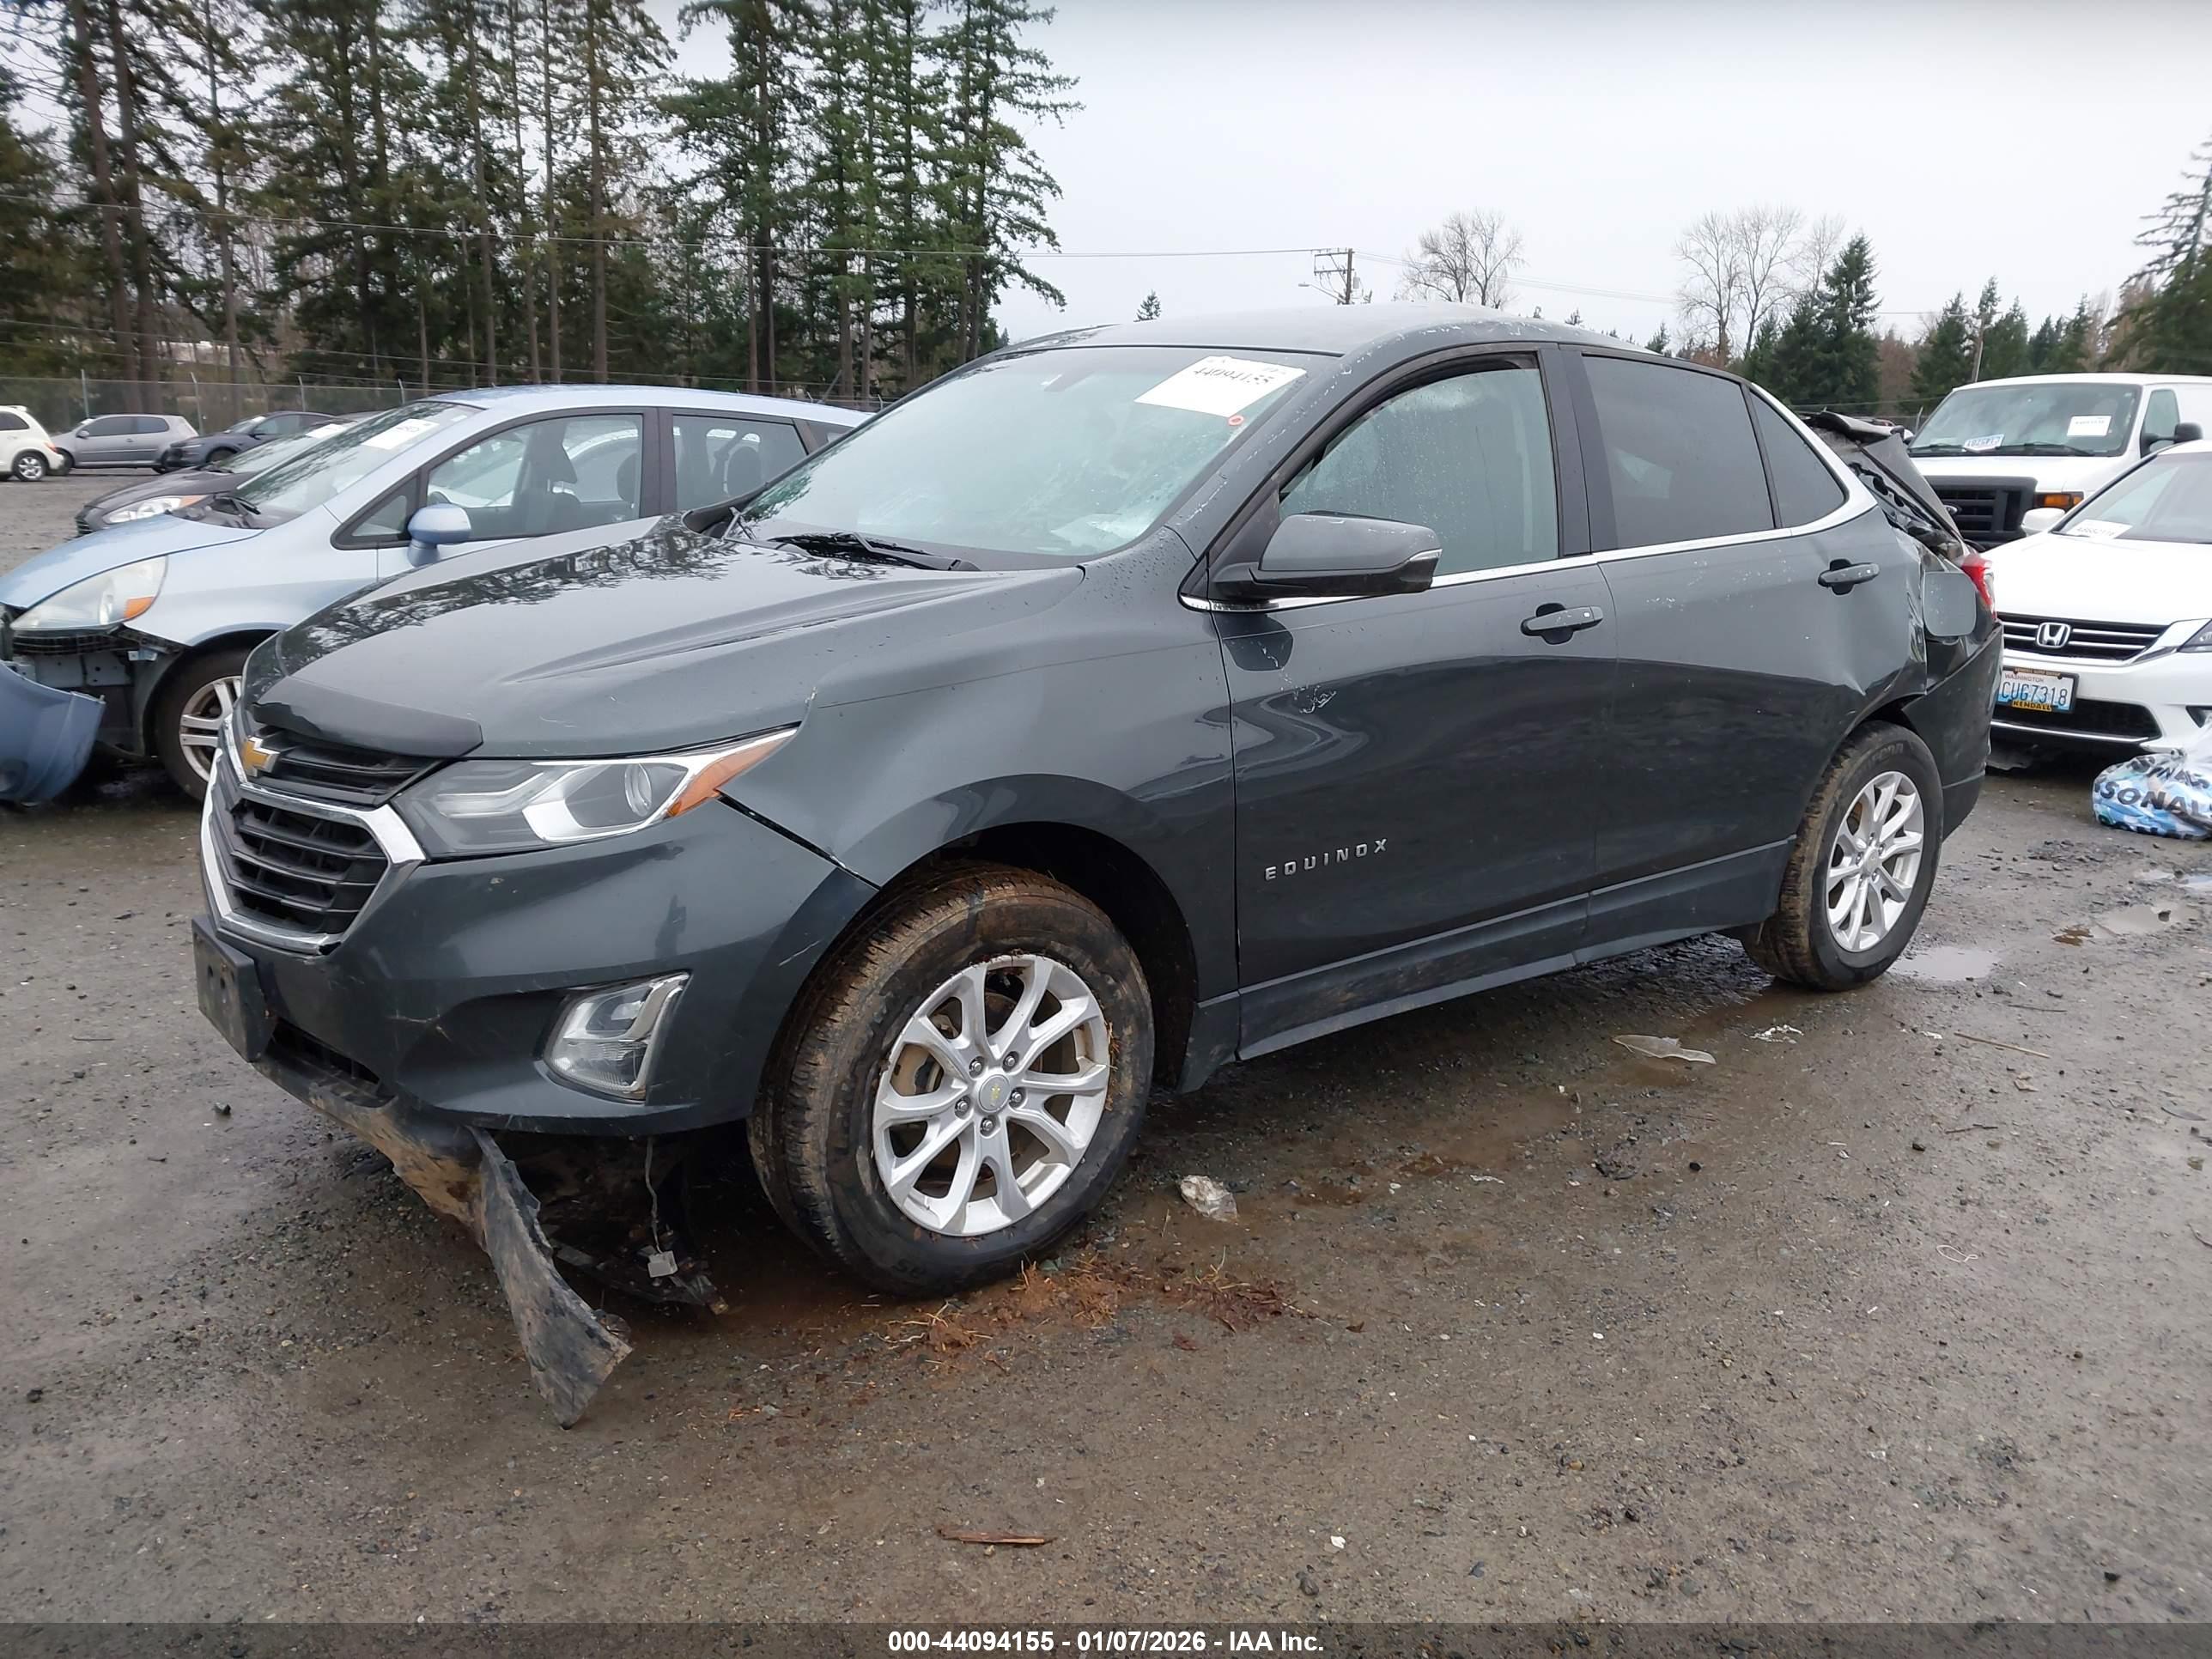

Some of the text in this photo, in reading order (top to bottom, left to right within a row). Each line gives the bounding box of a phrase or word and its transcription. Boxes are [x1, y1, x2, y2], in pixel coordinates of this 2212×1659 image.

[2001, 681, 2069, 707] CUG7318
[2013, 700, 2051, 711] KENDALL
[1265, 838, 1387, 881] EQUINOX
